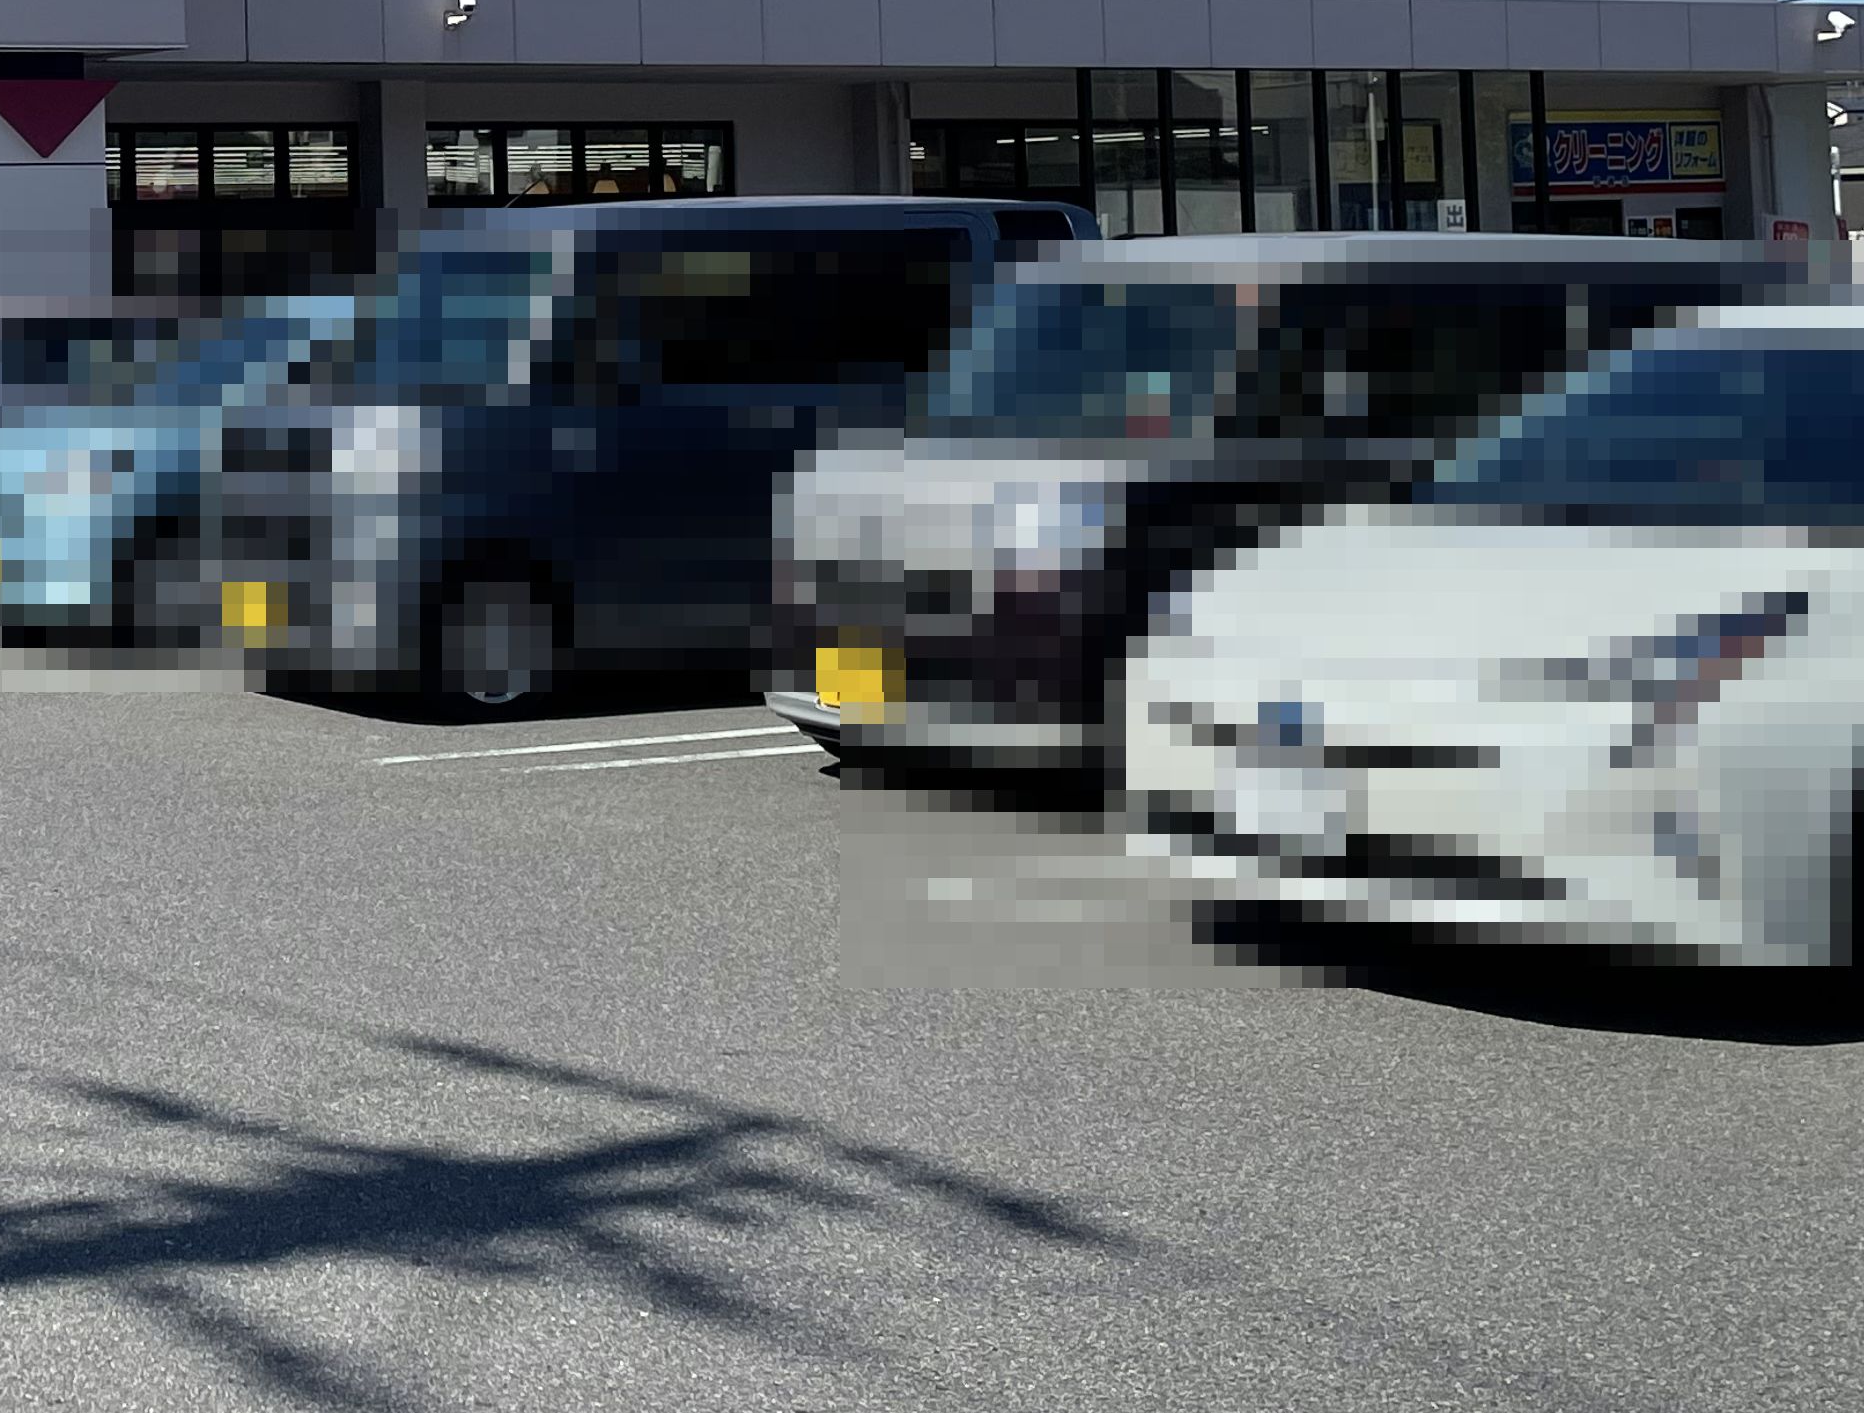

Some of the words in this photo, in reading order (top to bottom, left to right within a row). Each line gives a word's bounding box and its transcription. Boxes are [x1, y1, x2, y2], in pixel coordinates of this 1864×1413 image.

[1552, 126, 1664, 175] クリーニング
